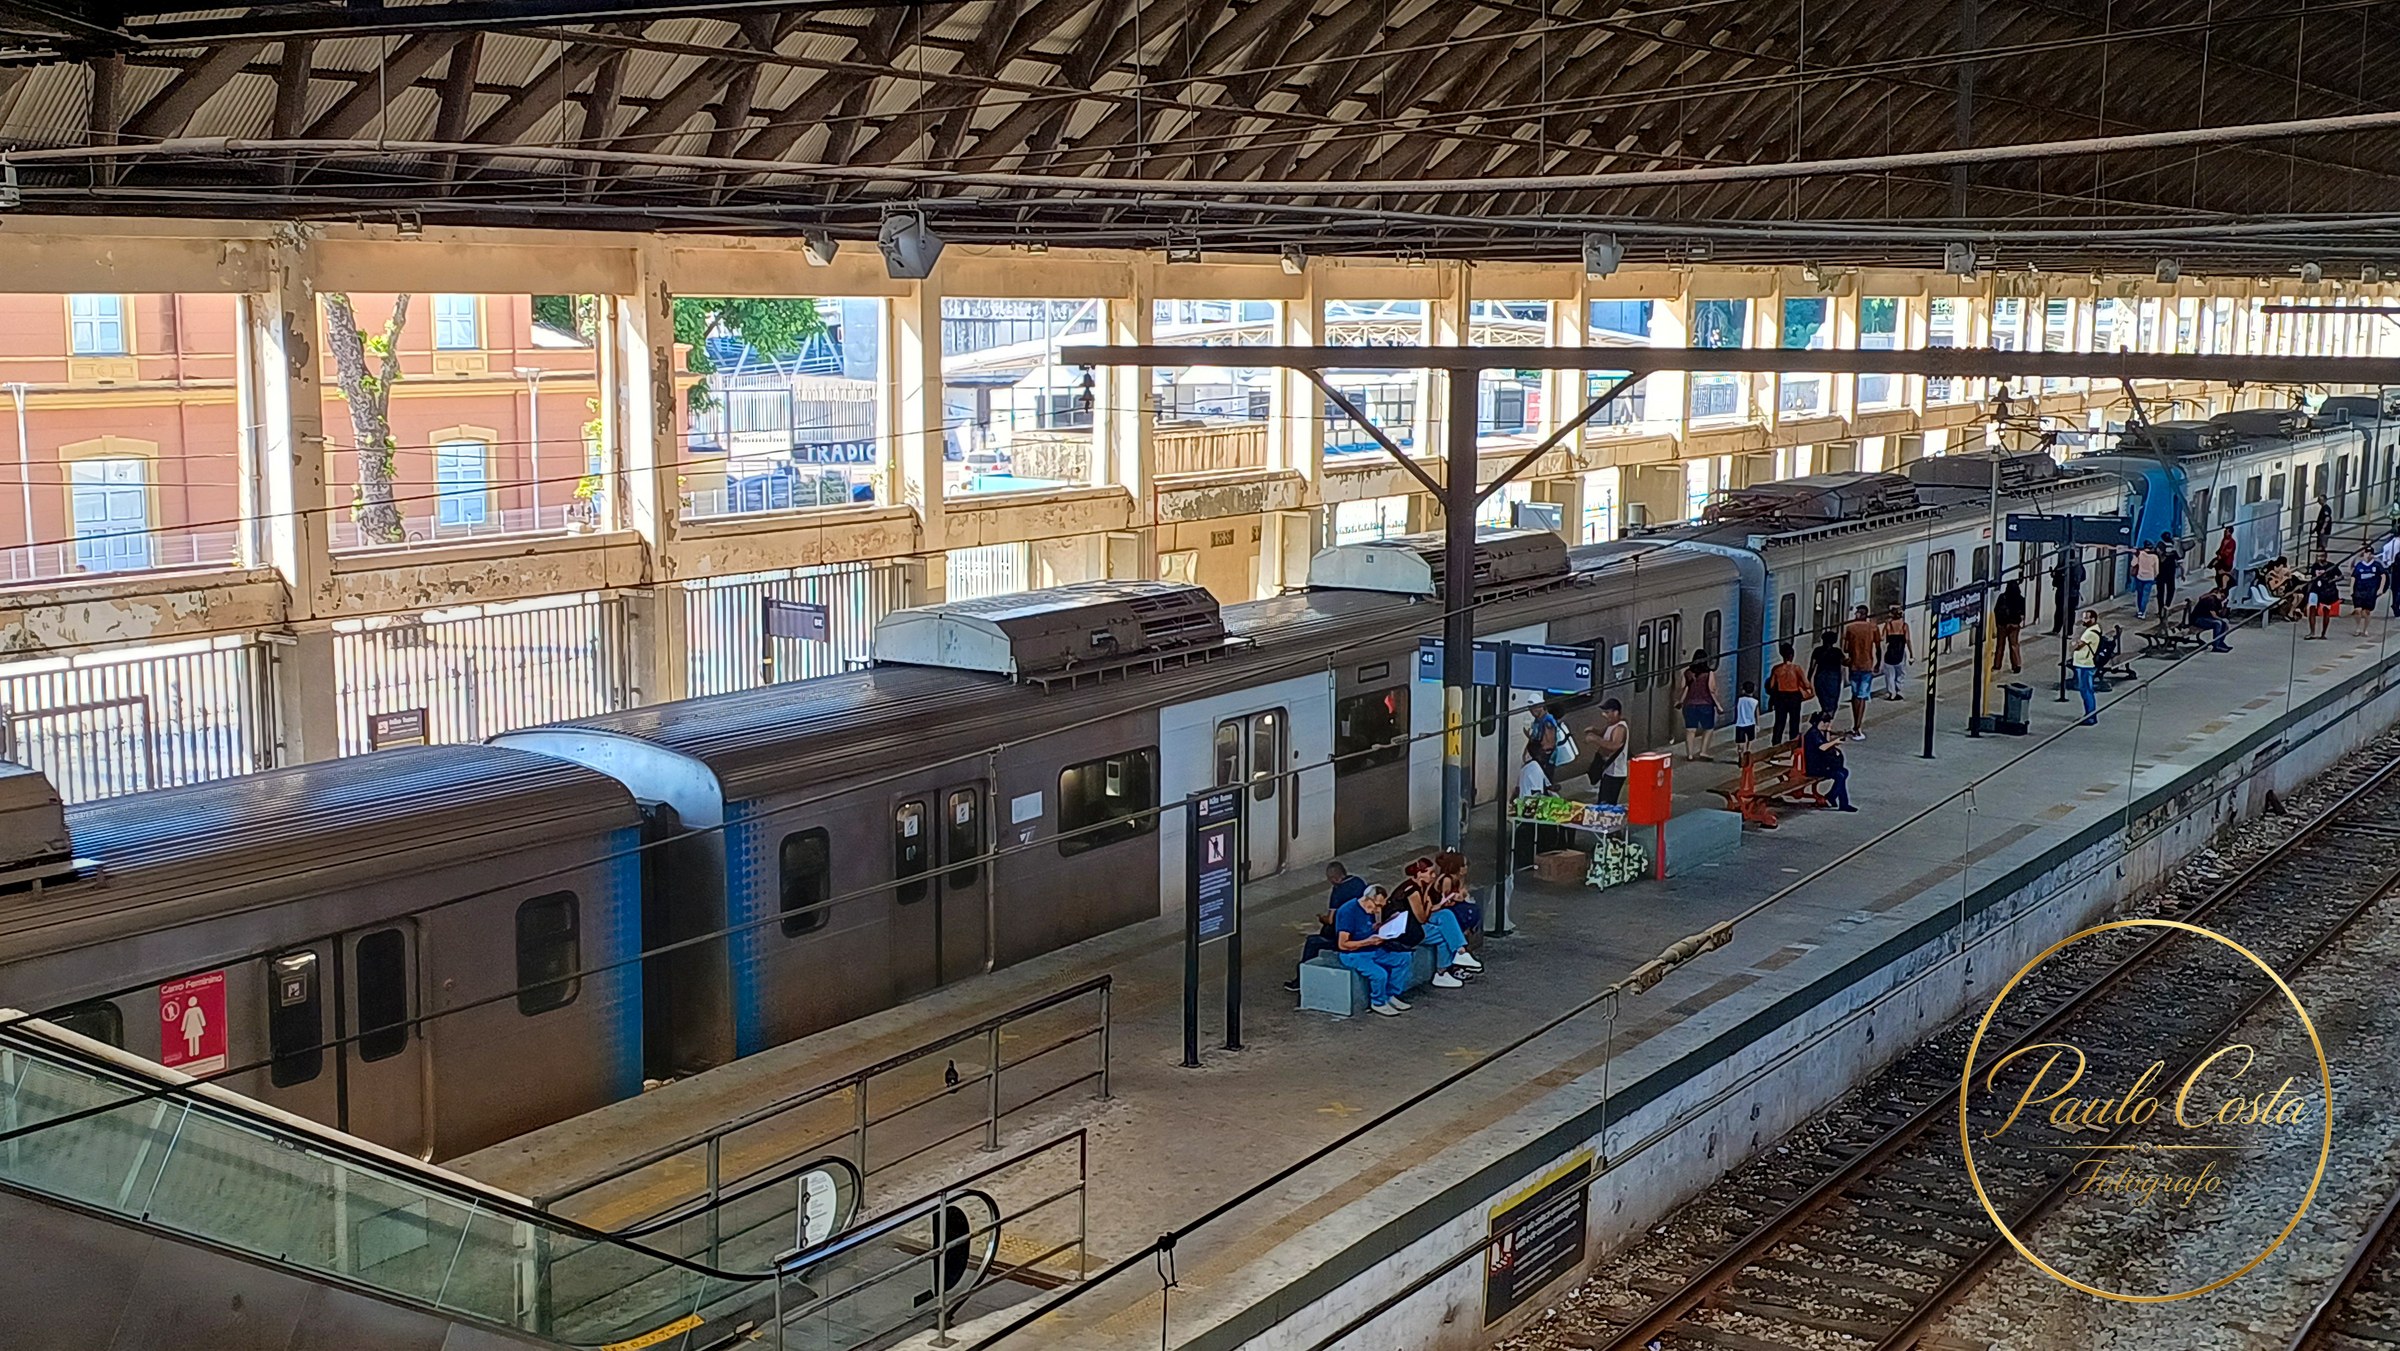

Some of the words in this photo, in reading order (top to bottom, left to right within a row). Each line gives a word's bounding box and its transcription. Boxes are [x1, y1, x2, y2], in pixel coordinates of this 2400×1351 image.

[1422, 653, 1435, 663] 4E
[1575, 666, 1590, 676] 4D
[161, 983, 184, 994] Carro
[185, 975, 223, 989] Feminino
